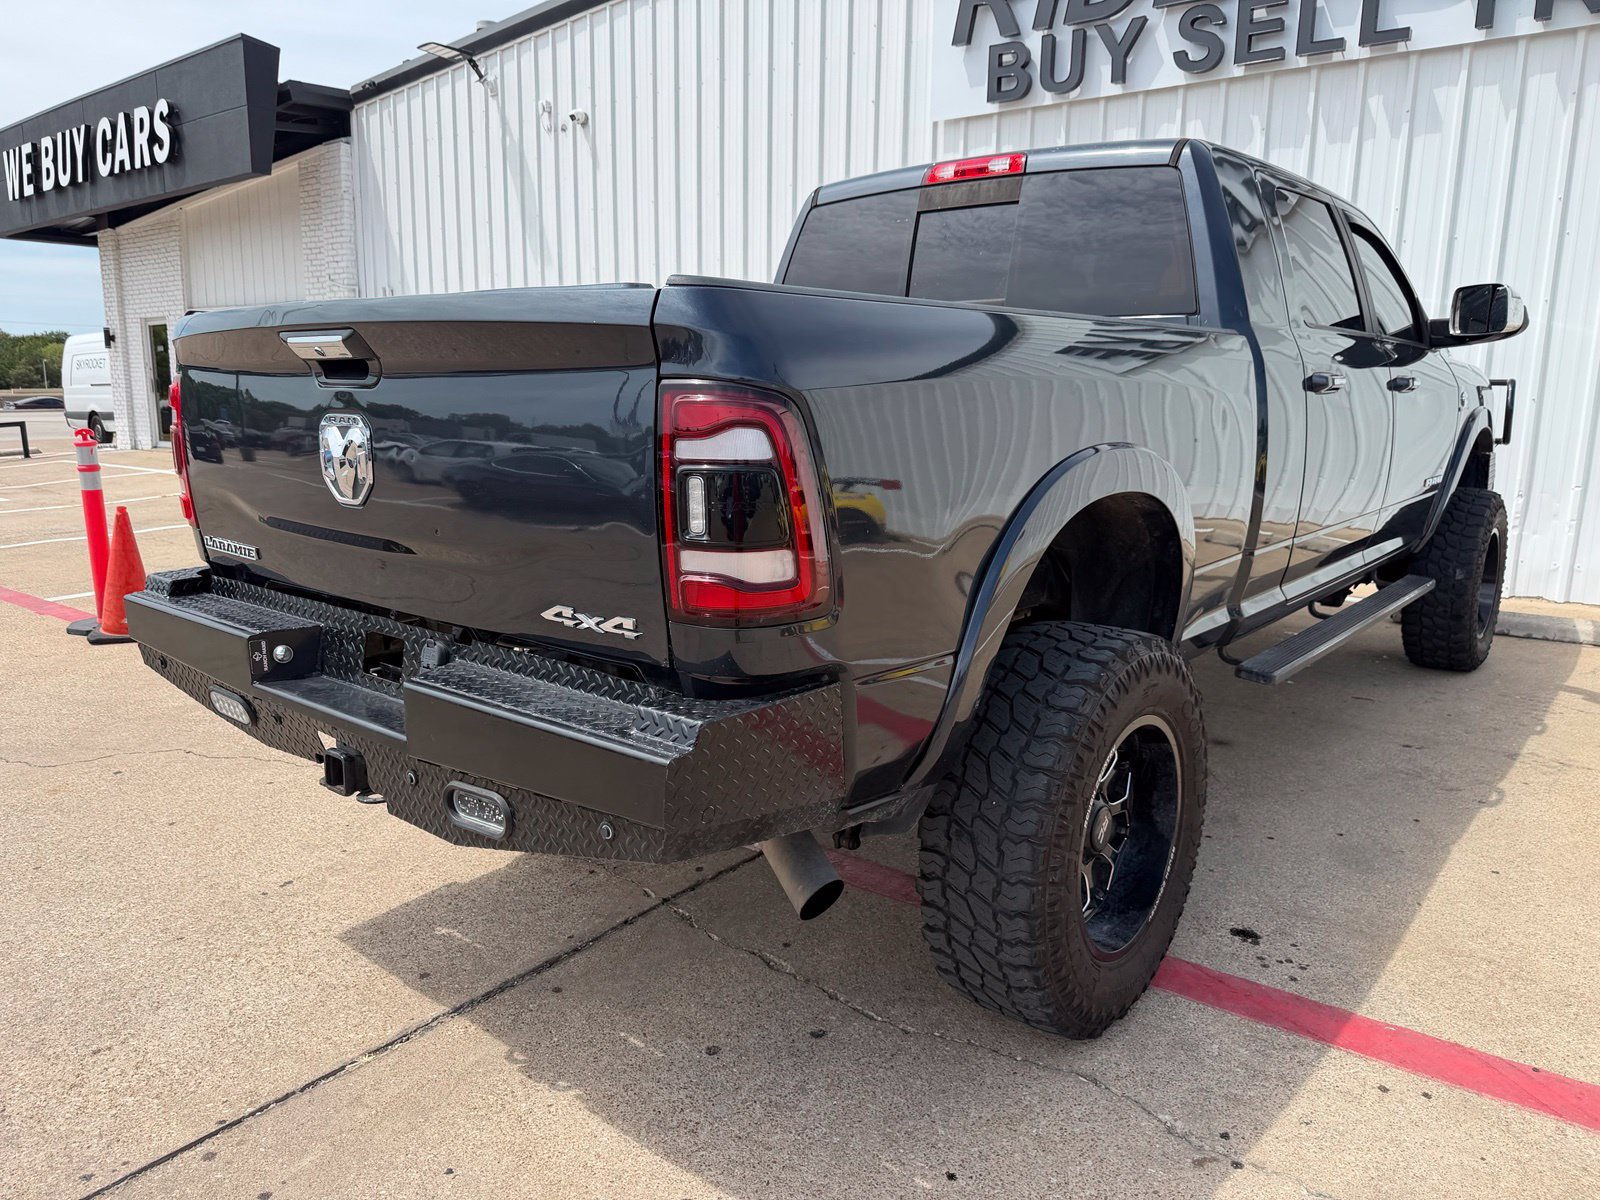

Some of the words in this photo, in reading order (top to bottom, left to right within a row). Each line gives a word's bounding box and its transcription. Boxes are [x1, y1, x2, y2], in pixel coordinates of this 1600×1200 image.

[987, 16, 1148, 103] BUY
[1173, 0, 1412, 74] SELL
[3, 142, 35, 201] WE
[41, 124, 86, 192] BUY
[96, 98, 171, 177] CARS
[328, 416, 360, 426] RAM
[205, 536, 256, 560] LARAMIE
